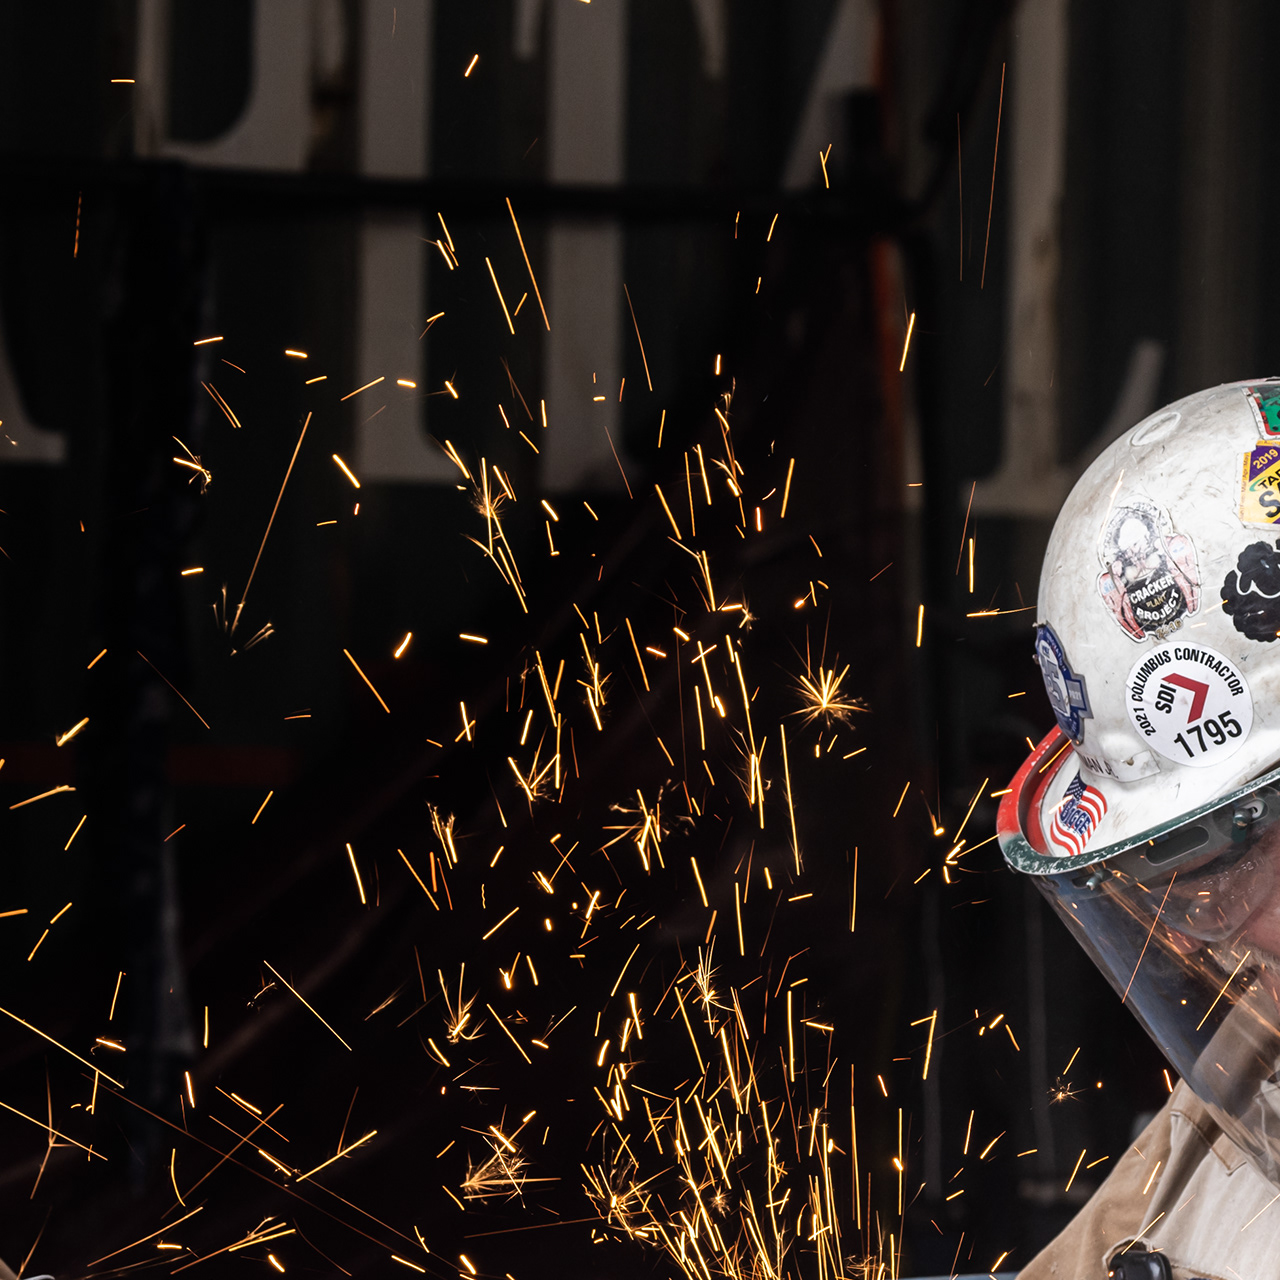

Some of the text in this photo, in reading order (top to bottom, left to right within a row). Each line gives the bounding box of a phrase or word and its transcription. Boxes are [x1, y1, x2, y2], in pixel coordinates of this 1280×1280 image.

[1252, 448, 1279, 470] 2019
[1130, 574, 1176, 605] CRACKER
[1135, 588, 1179, 621] PROJECT
[1145, 591, 1167, 608] PLANT
[1131, 647, 1244, 737] 2021 COLUMBUS CONTRACTOR
[1154, 683, 1177, 714] SDI
[1173, 709, 1243, 758] 1795
